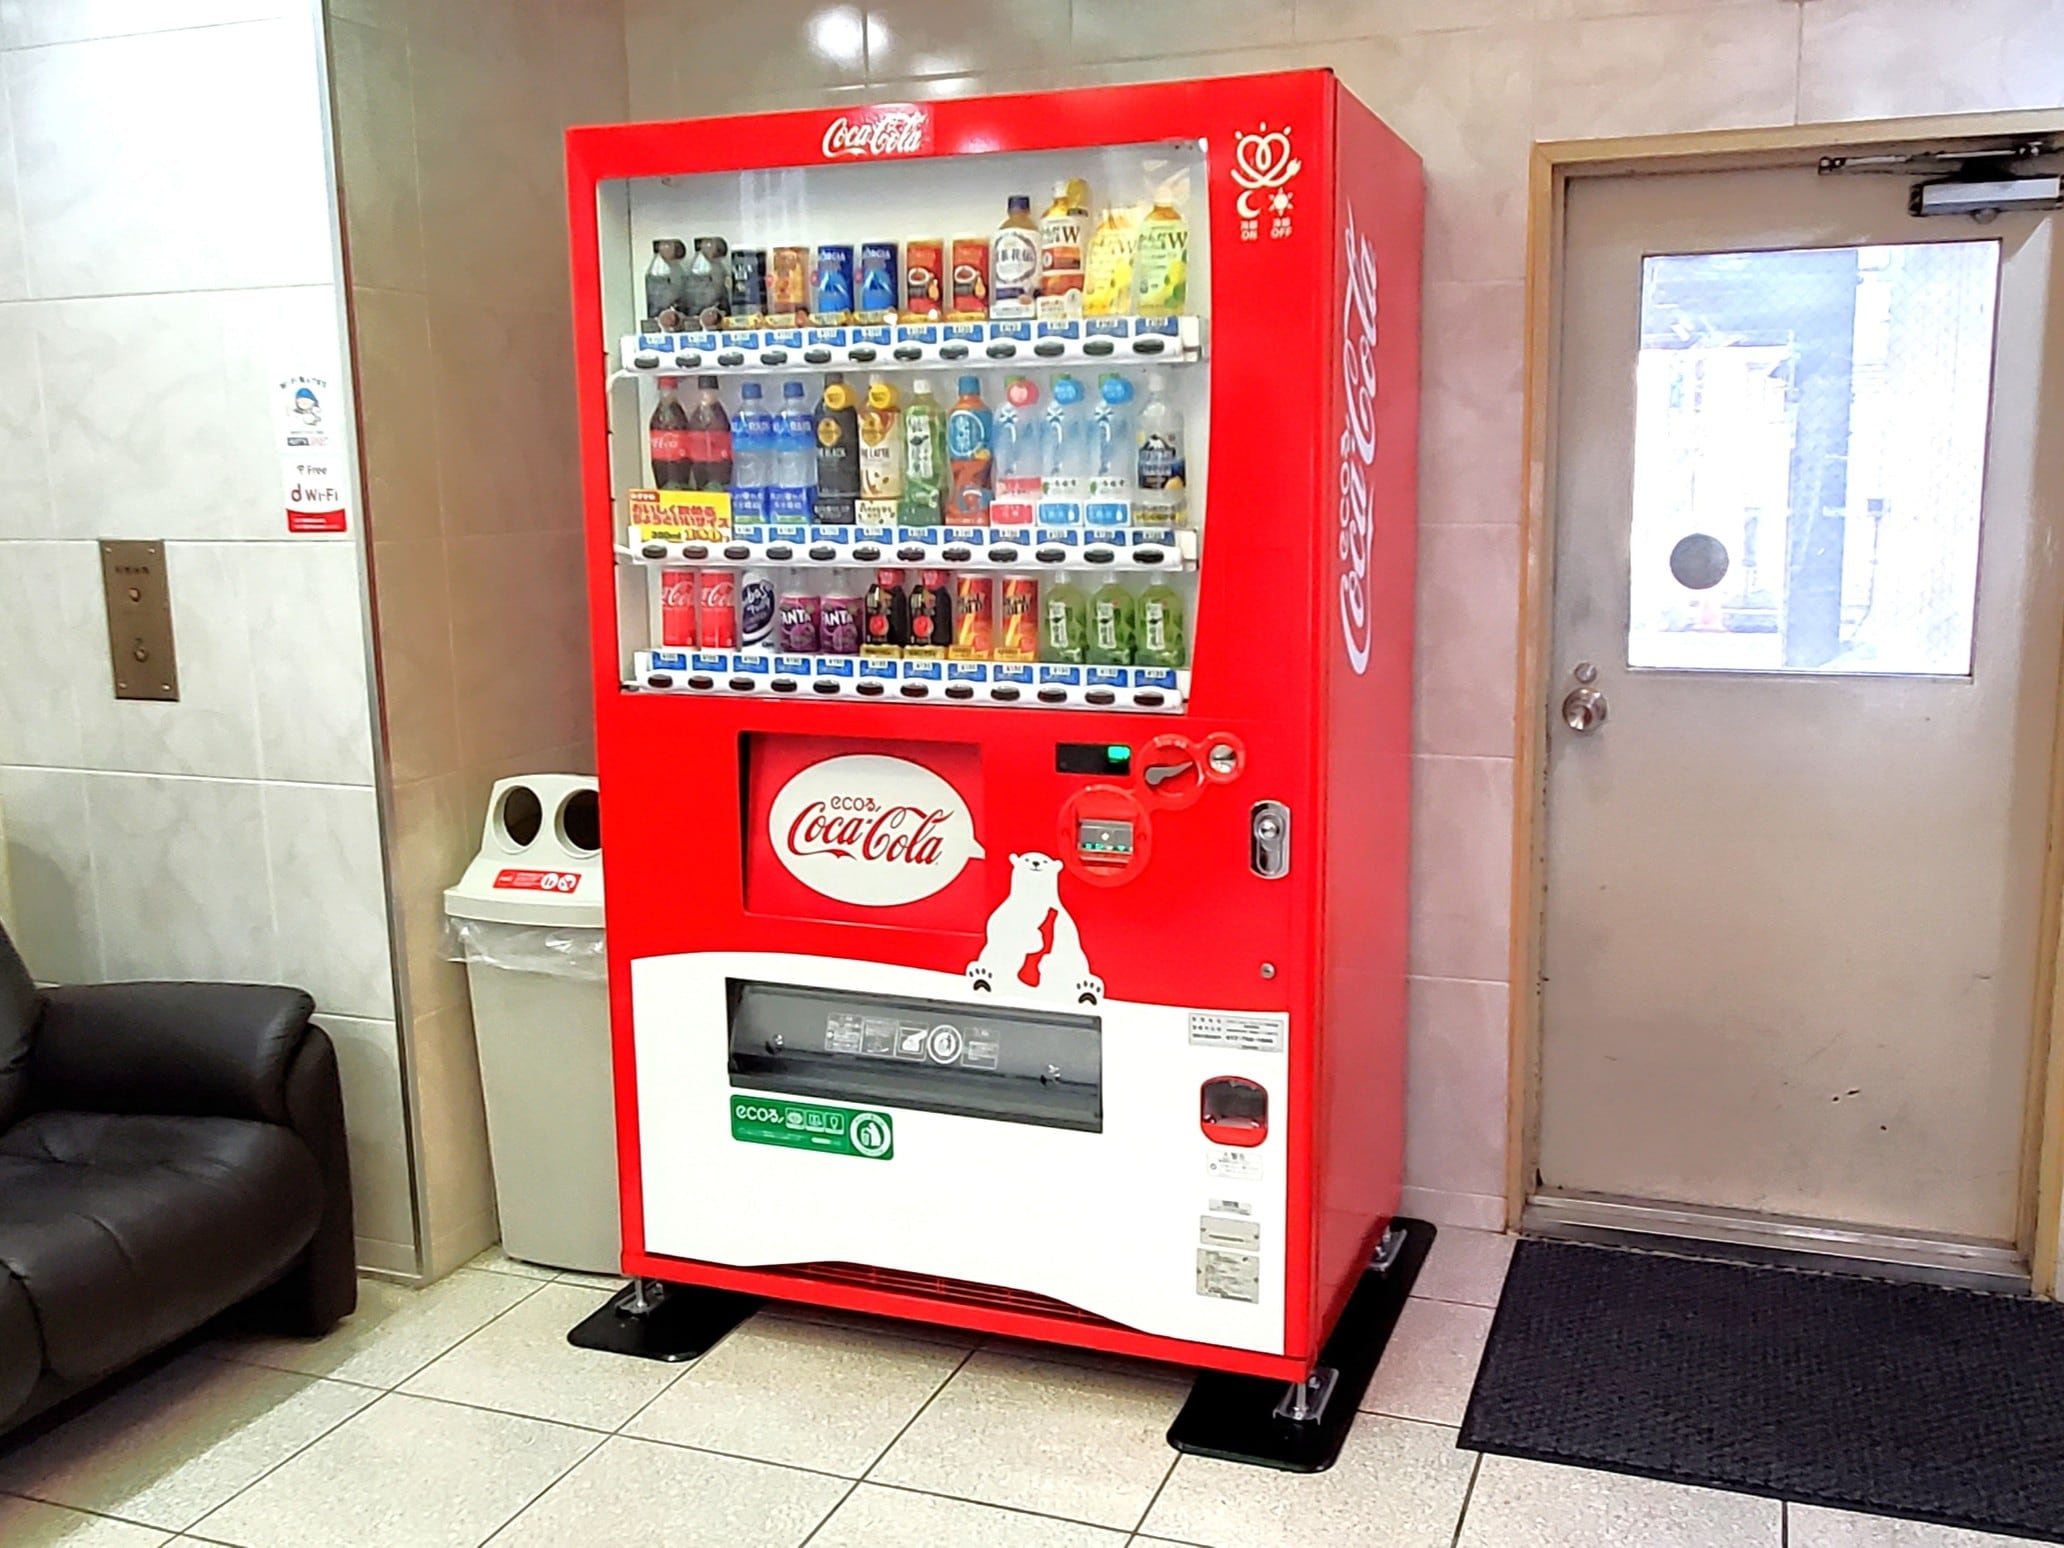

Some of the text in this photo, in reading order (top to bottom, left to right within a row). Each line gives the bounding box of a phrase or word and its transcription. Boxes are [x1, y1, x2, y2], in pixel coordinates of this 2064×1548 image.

[822, 112, 928, 158] Coca-Cola
[1340, 196, 1378, 676] Coca-Cola
[787, 801, 955, 865] Coca-Cola
